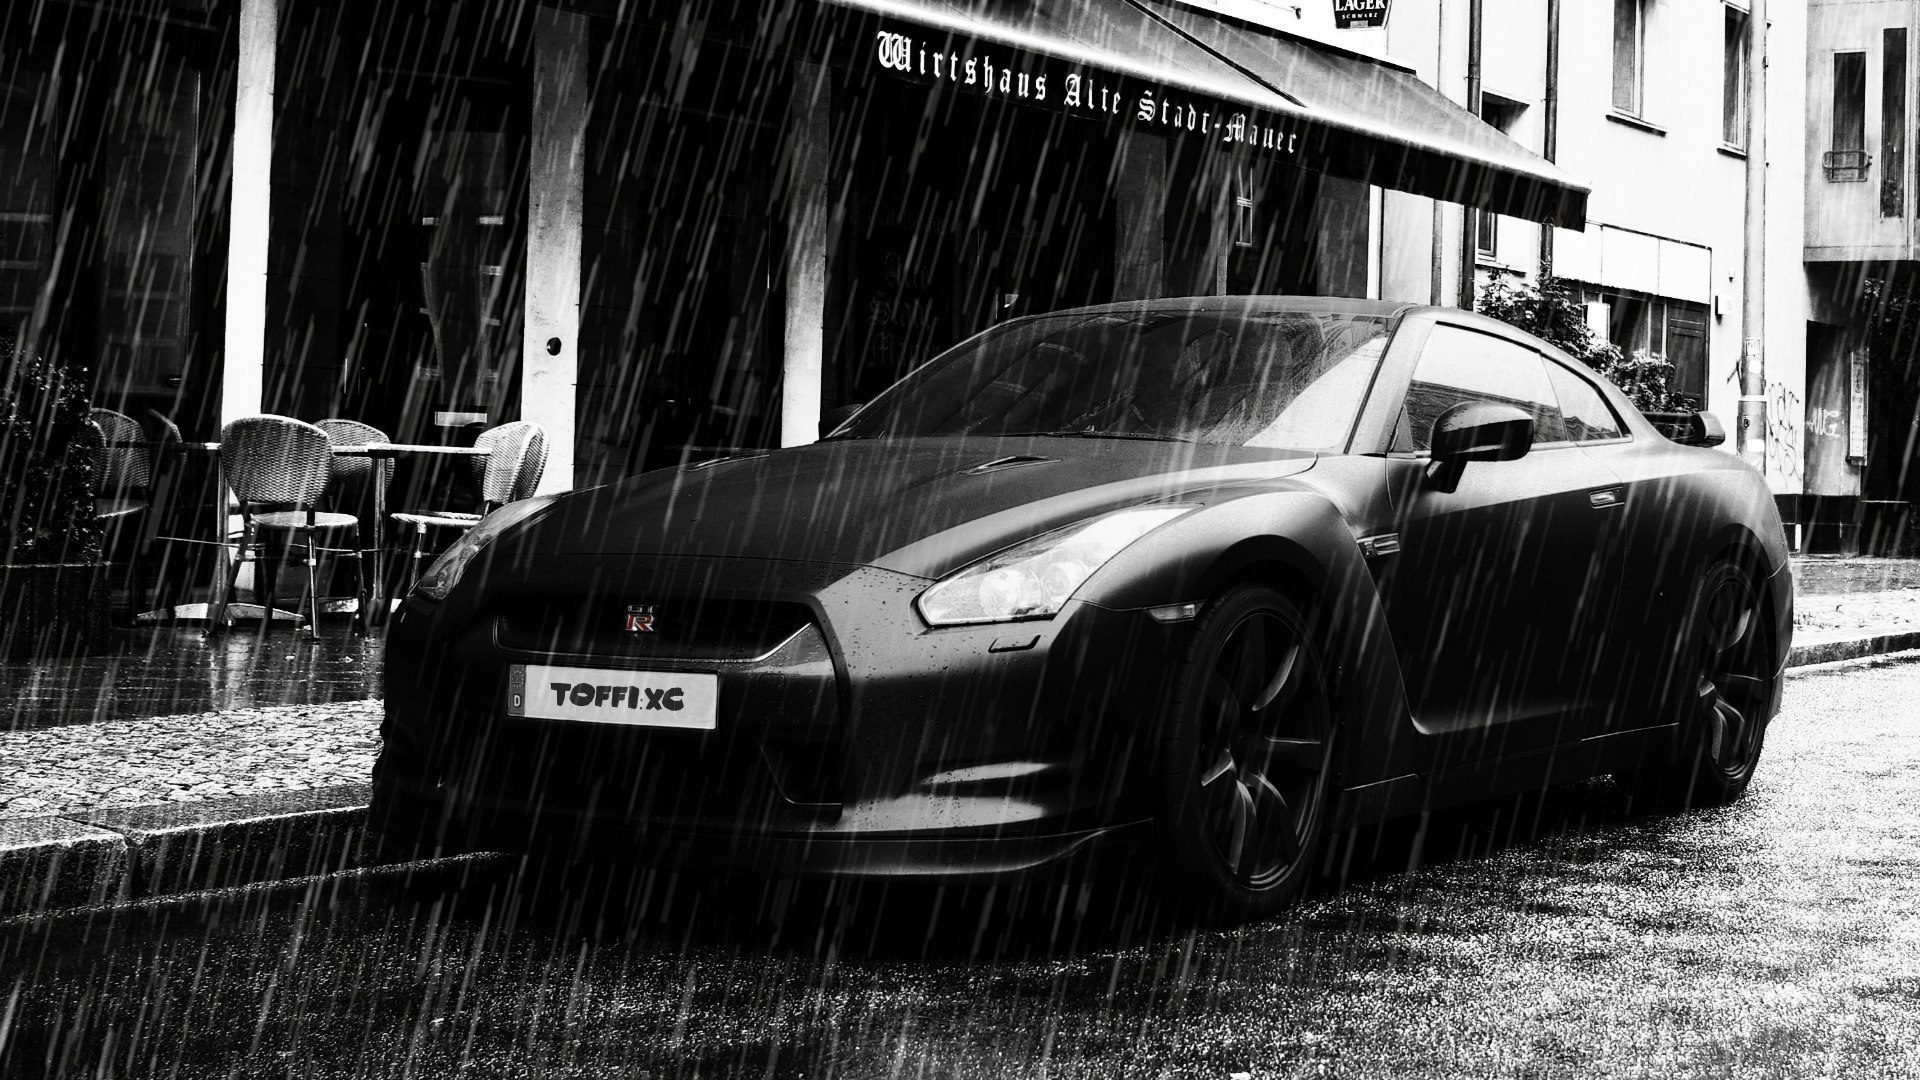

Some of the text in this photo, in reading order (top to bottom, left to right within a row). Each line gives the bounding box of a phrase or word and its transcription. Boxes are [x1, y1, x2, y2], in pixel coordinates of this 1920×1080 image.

[1335, 0, 1386, 11] LAGER
[877, 30, 1047, 100] Wirtshaus
[1064, 73, 1121, 114] Alte
[513, 694, 521, 707] D
